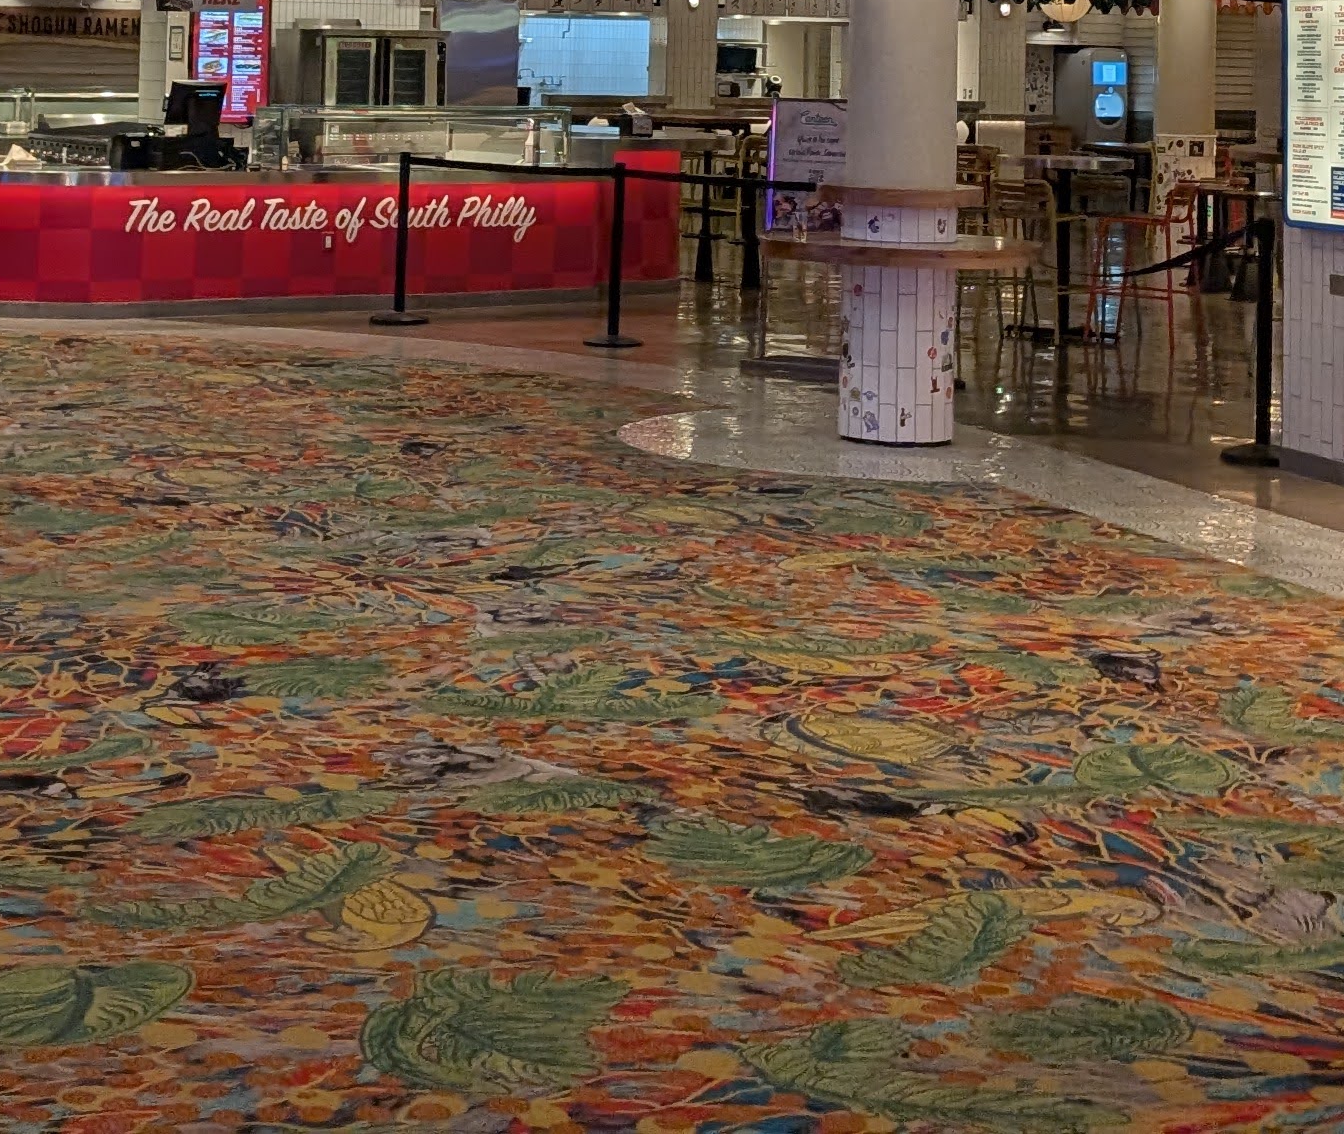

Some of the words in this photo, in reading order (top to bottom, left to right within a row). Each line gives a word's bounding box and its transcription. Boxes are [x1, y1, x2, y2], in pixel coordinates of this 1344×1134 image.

[8, 14, 77, 36] SHOGUN
[84, 16, 141, 37] RAMEN
[125, 197, 176, 232] The
[183, 198, 256, 232] Real
[260, 198, 329, 231] Taste
[335, 196, 367, 243] of
[457, 194, 537, 243] Philly
